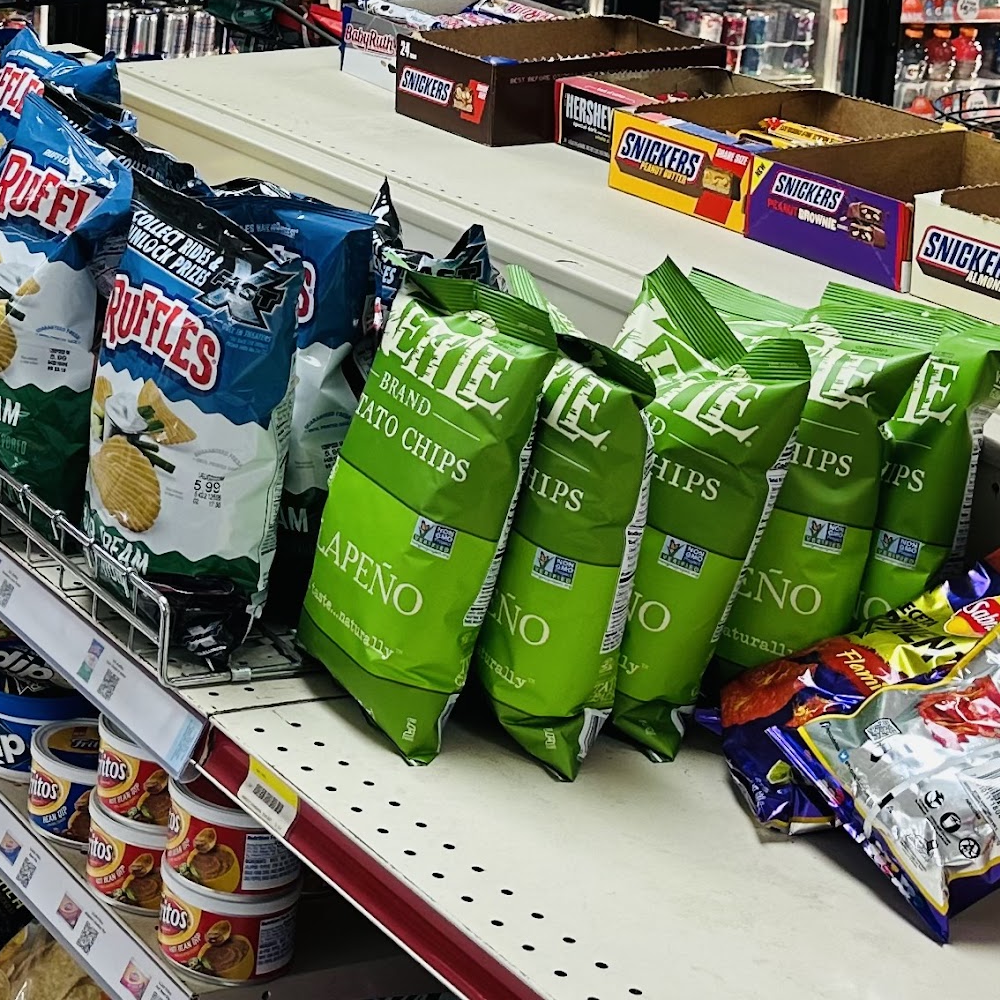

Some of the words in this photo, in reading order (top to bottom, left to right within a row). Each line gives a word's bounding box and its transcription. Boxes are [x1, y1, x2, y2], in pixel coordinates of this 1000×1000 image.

[400, 40, 411, 58] 24
[401, 69, 450, 101] SNICKERS
[564, 92, 612, 132] HERSHEY
[621, 132, 700, 178] SNICKERS
[734, 152, 749, 165] SIZE
[639, 161, 663, 178] PEANUT
[663, 168, 687, 185] BUTTER
[754, 161, 766, 178] NEW
[775, 174, 842, 212] SNICKERS
[767, 198, 798, 218] PEANUT
[798, 208, 837, 231] BROWNIE
[132, 210, 184, 250] COLLECT
[179, 237, 215, 269] RIDES
[209, 256, 224, 272] &
[171, 256, 212, 287] PRIZES
[965, 271, 1000, 293] ALMON
[104, 278, 217, 386] RUFFLES
[379, 370, 432, 418] BRAND
[355, 392, 399, 439] TATO
[401, 426, 471, 483] CHIPS
[650, 455, 721, 502] HIPS
[413, 533, 451, 554] VERIFIED
[804, 537, 842, 549] VERIFIED
[534, 565, 571, 584] VERIFIED
[556, 558, 576, 569] NON
[660, 551, 700, 575] VERIFIED
[901, 601, 939, 628] ECETA
[98, 752, 127, 781] ritos
[29, 769, 59, 800] ritos
[117, 791, 132, 803] BEAN
[131, 782, 141, 798] DIP
[42, 811, 56, 824] BEAN
[56, 805, 68, 820] DIP
[103, 871, 117, 884] BEAN
[116, 864, 126, 878] DIP
[177, 939, 192, 952] BEAN
[191, 931, 202, 947] DIP
